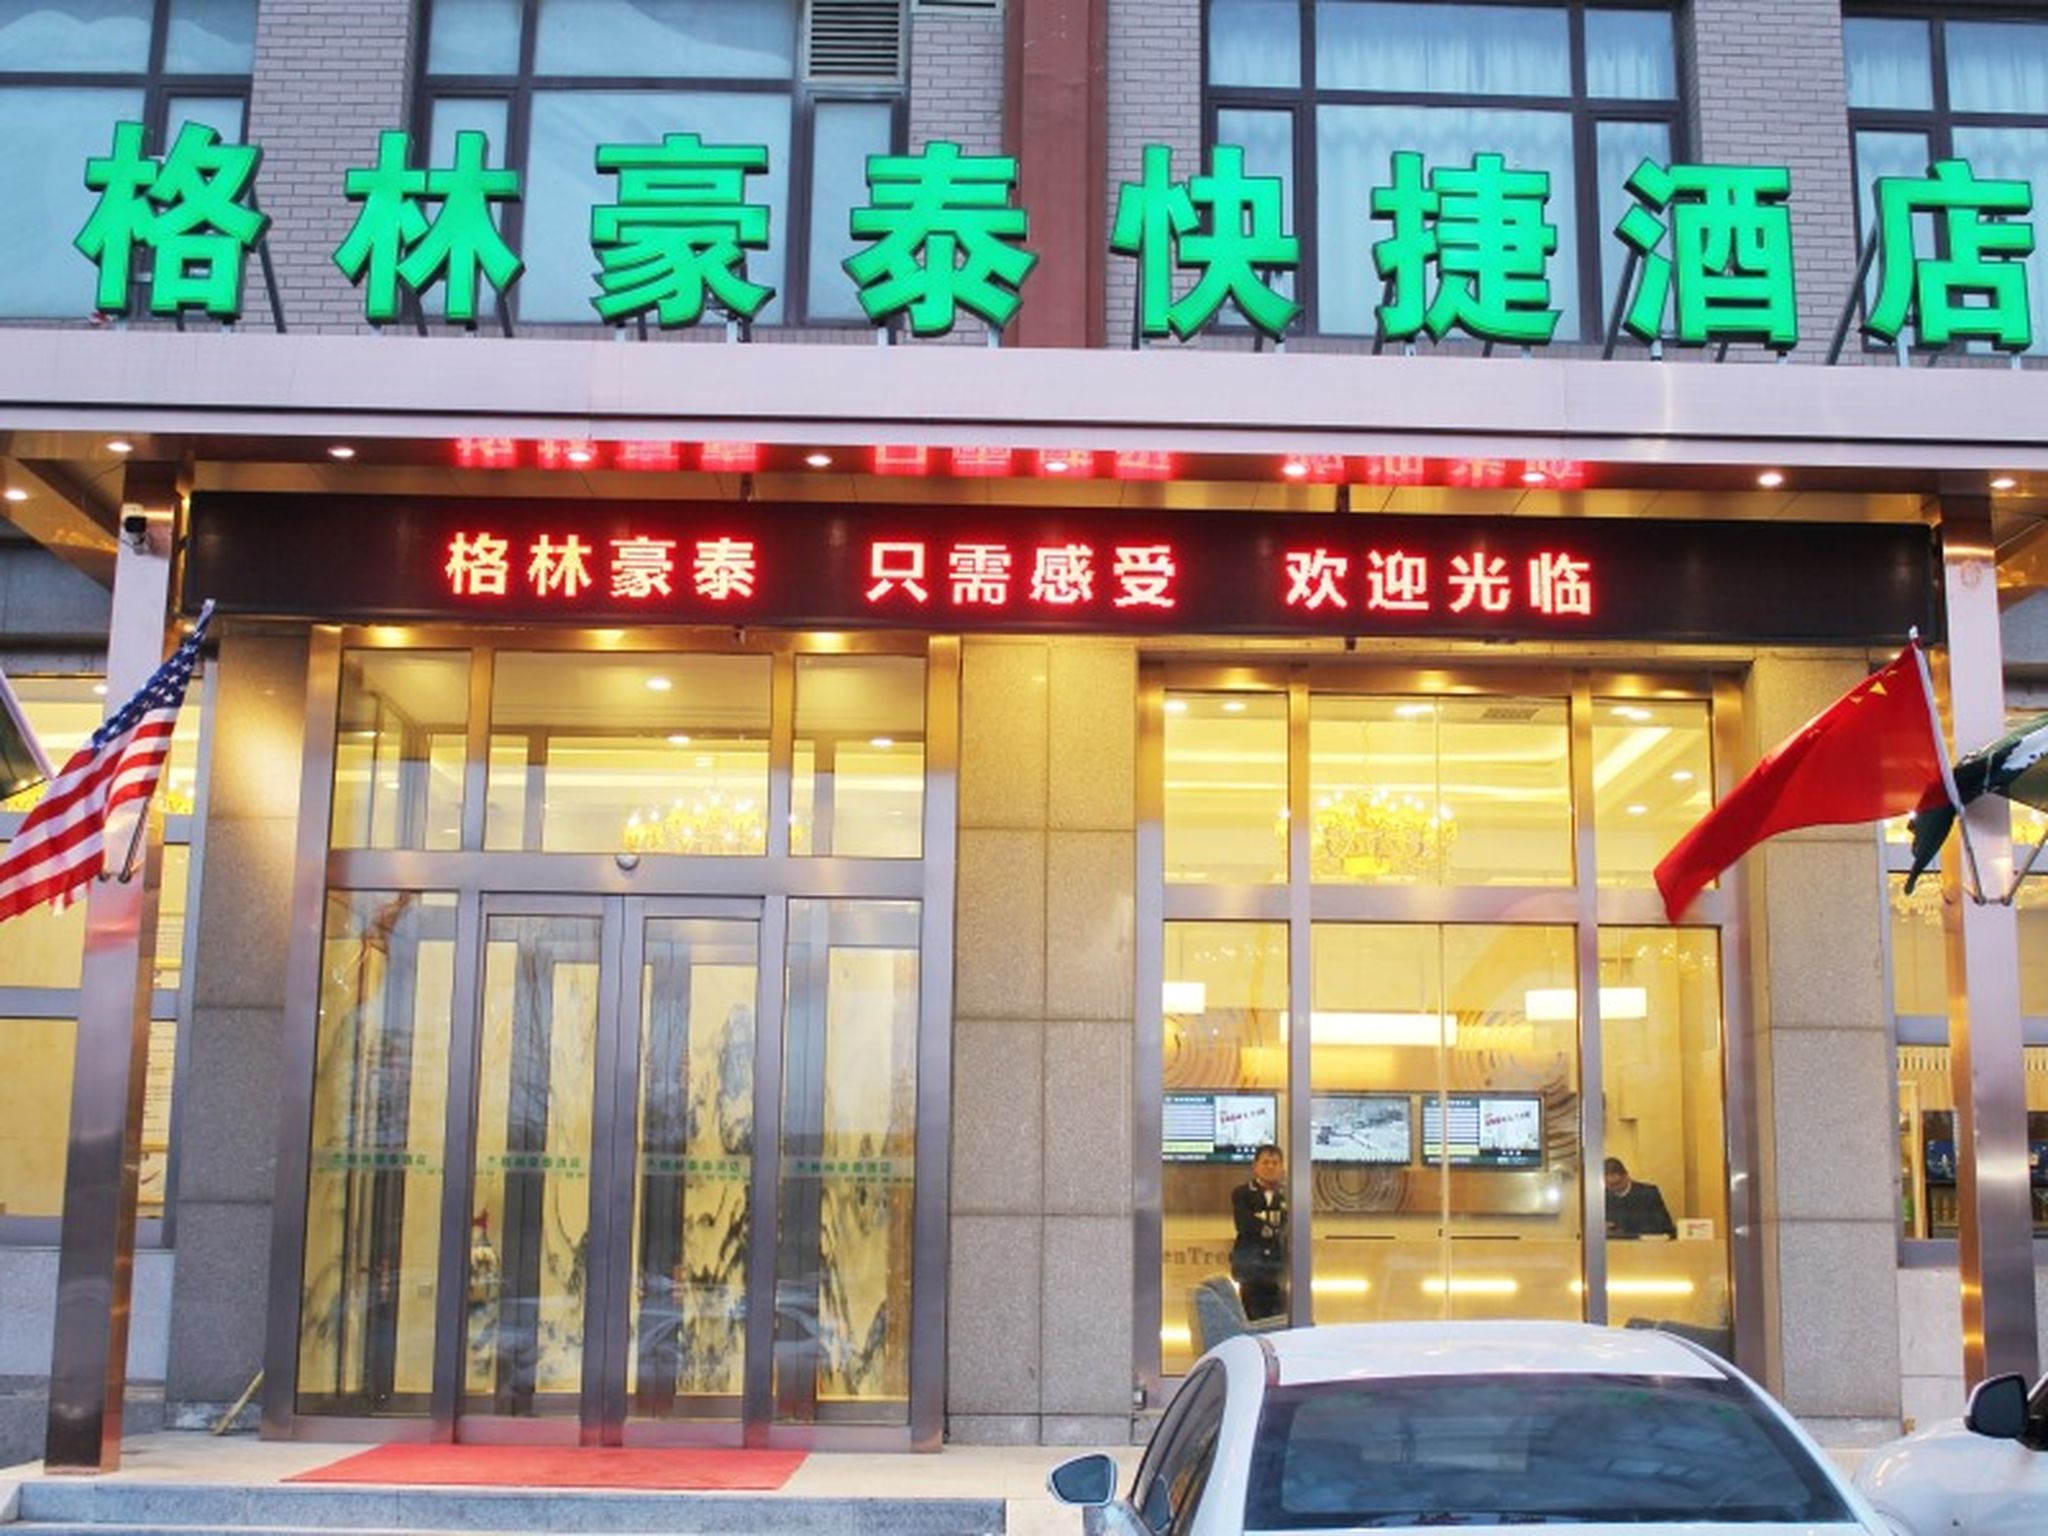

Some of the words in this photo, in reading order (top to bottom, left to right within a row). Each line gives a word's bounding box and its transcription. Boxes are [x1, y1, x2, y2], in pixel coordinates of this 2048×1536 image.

[73, 121, 2036, 351] 格林豪泰快捷酒店
[444, 531, 756, 600] 格林豪泰
[866, 541, 1177, 608] 只需感受
[1285, 548, 1592, 616] 欢迎光临
